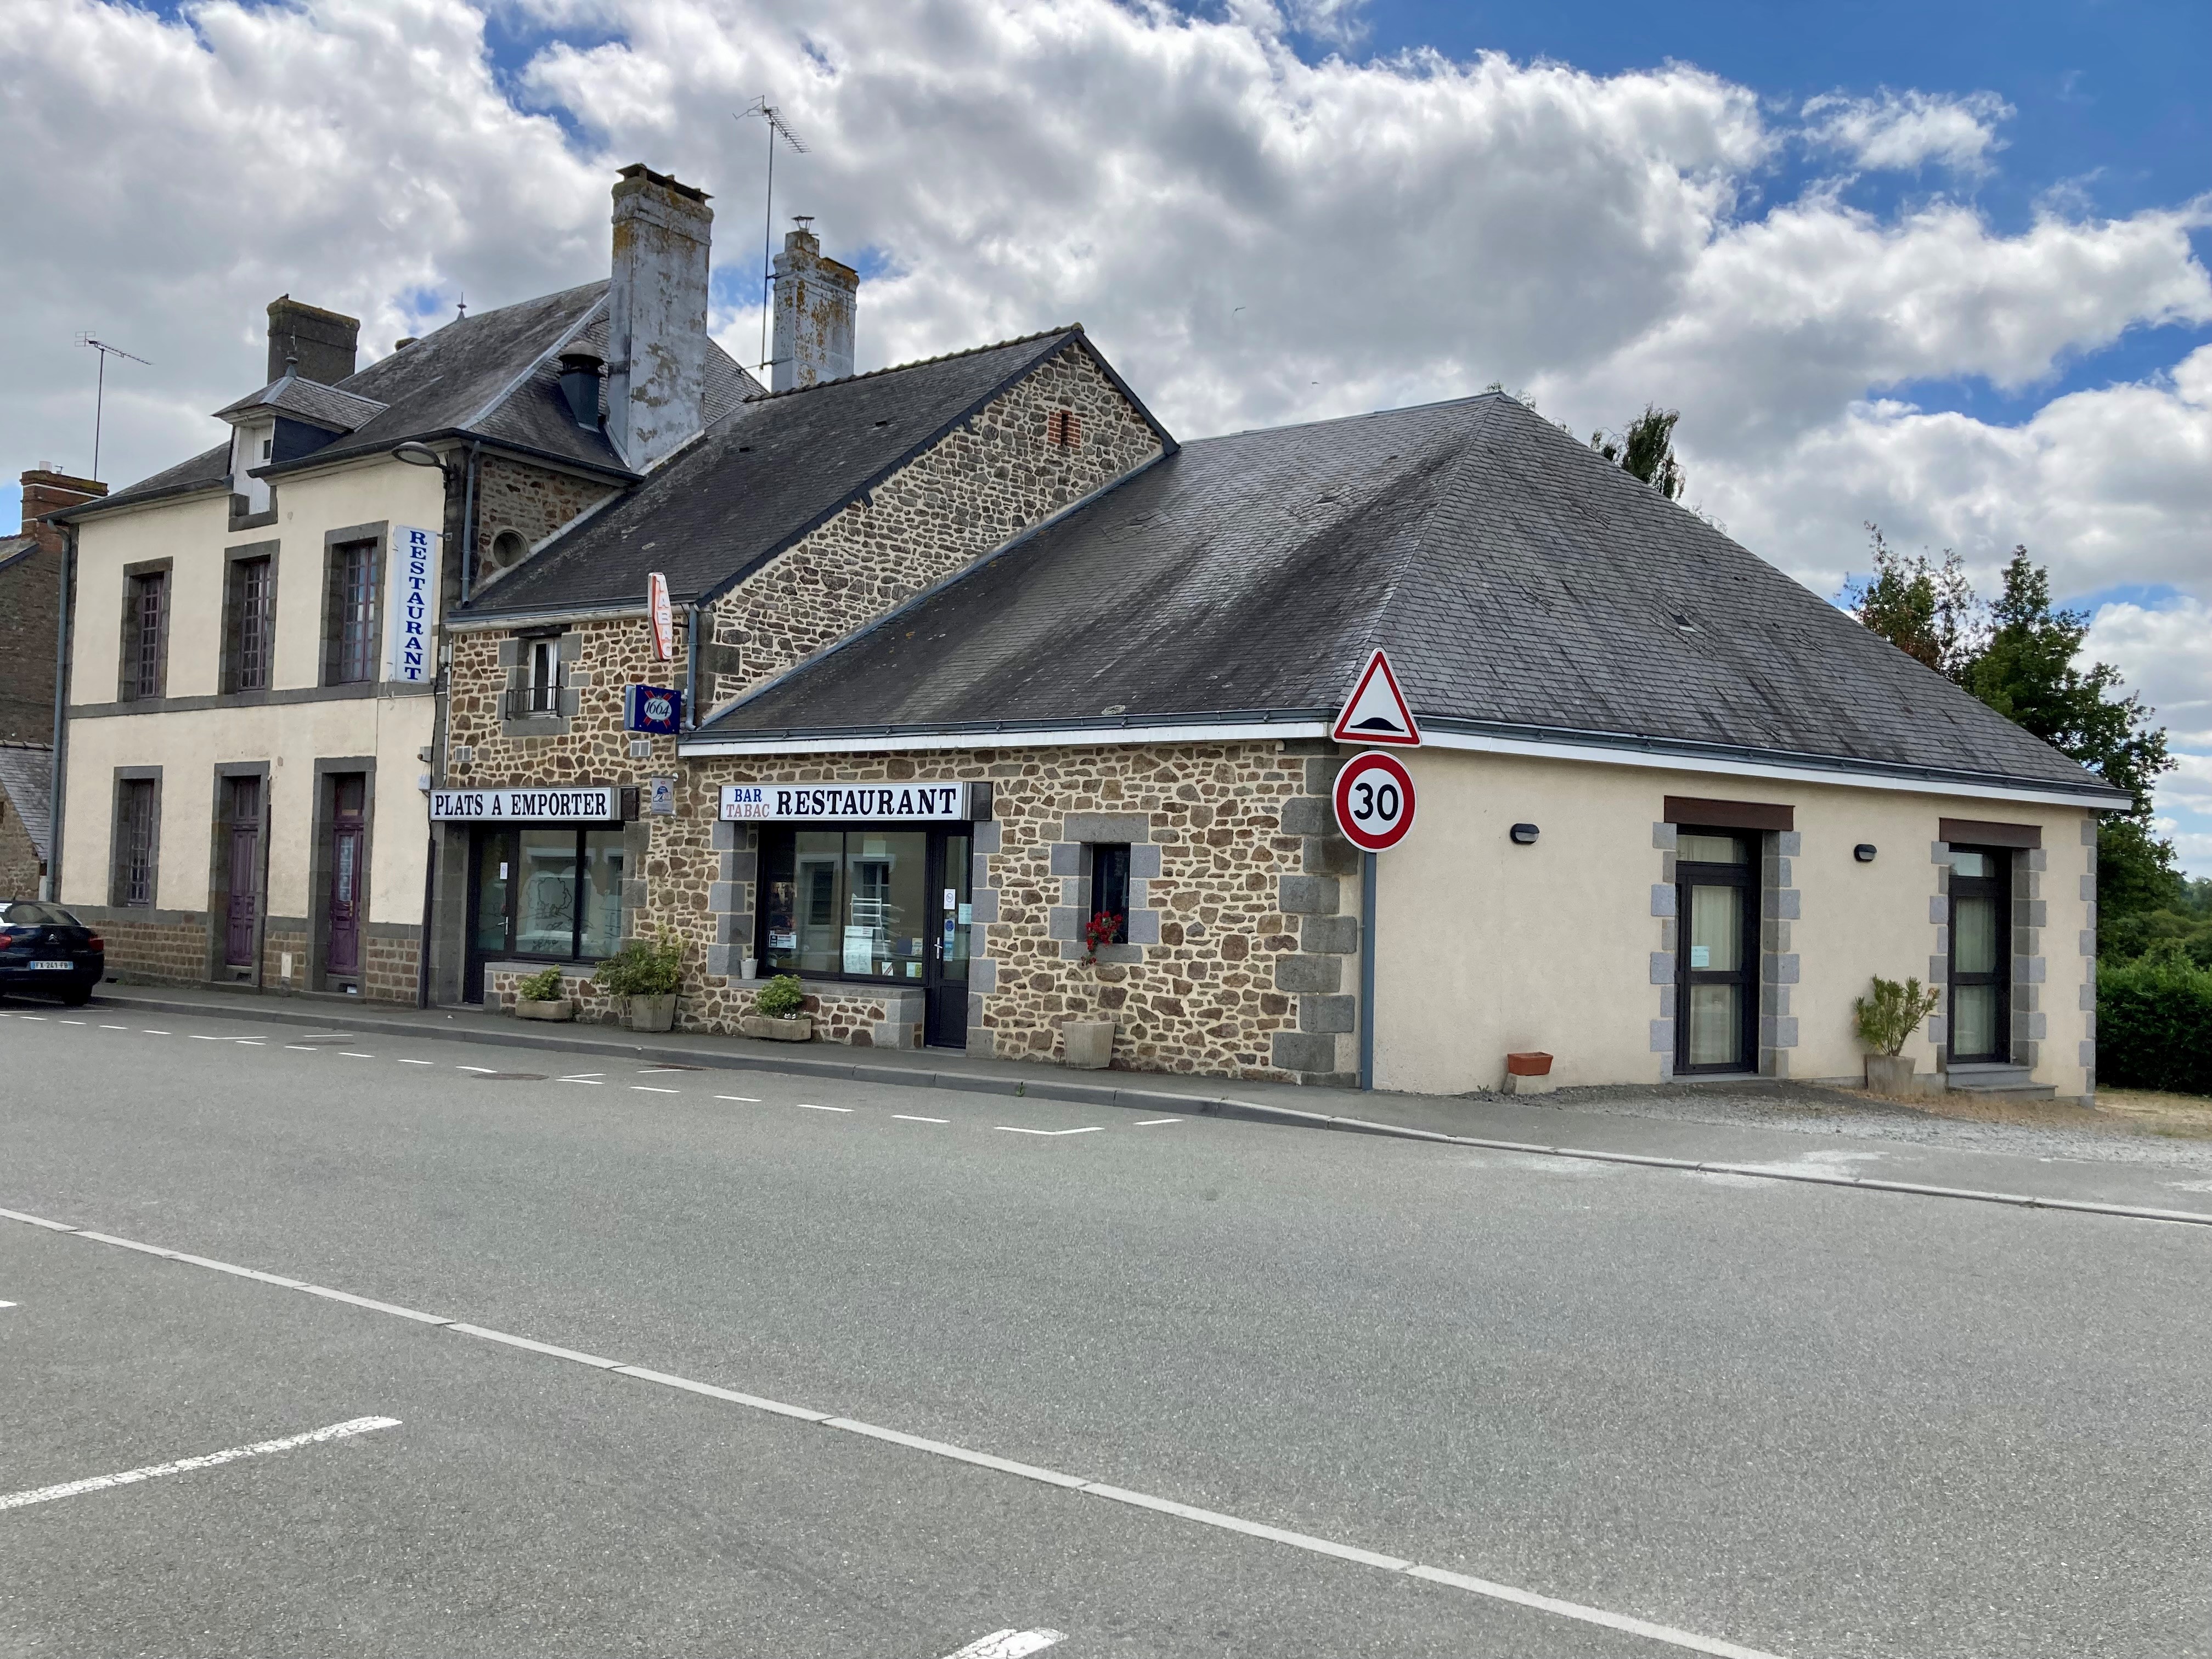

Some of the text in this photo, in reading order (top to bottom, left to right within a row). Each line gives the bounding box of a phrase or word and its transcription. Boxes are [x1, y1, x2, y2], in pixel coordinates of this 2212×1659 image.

[404, 531, 427, 680] RESTAURANT
[656, 578, 673, 657] TABAC
[646, 701, 670, 716] 1664
[435, 792, 607, 816] PLATS A EMPORTER
[734, 788, 762, 802] BAR
[776, 788, 956, 815] RESTAURANT
[1353, 782, 1399, 821] 30
[726, 804, 770, 817] TABAC
